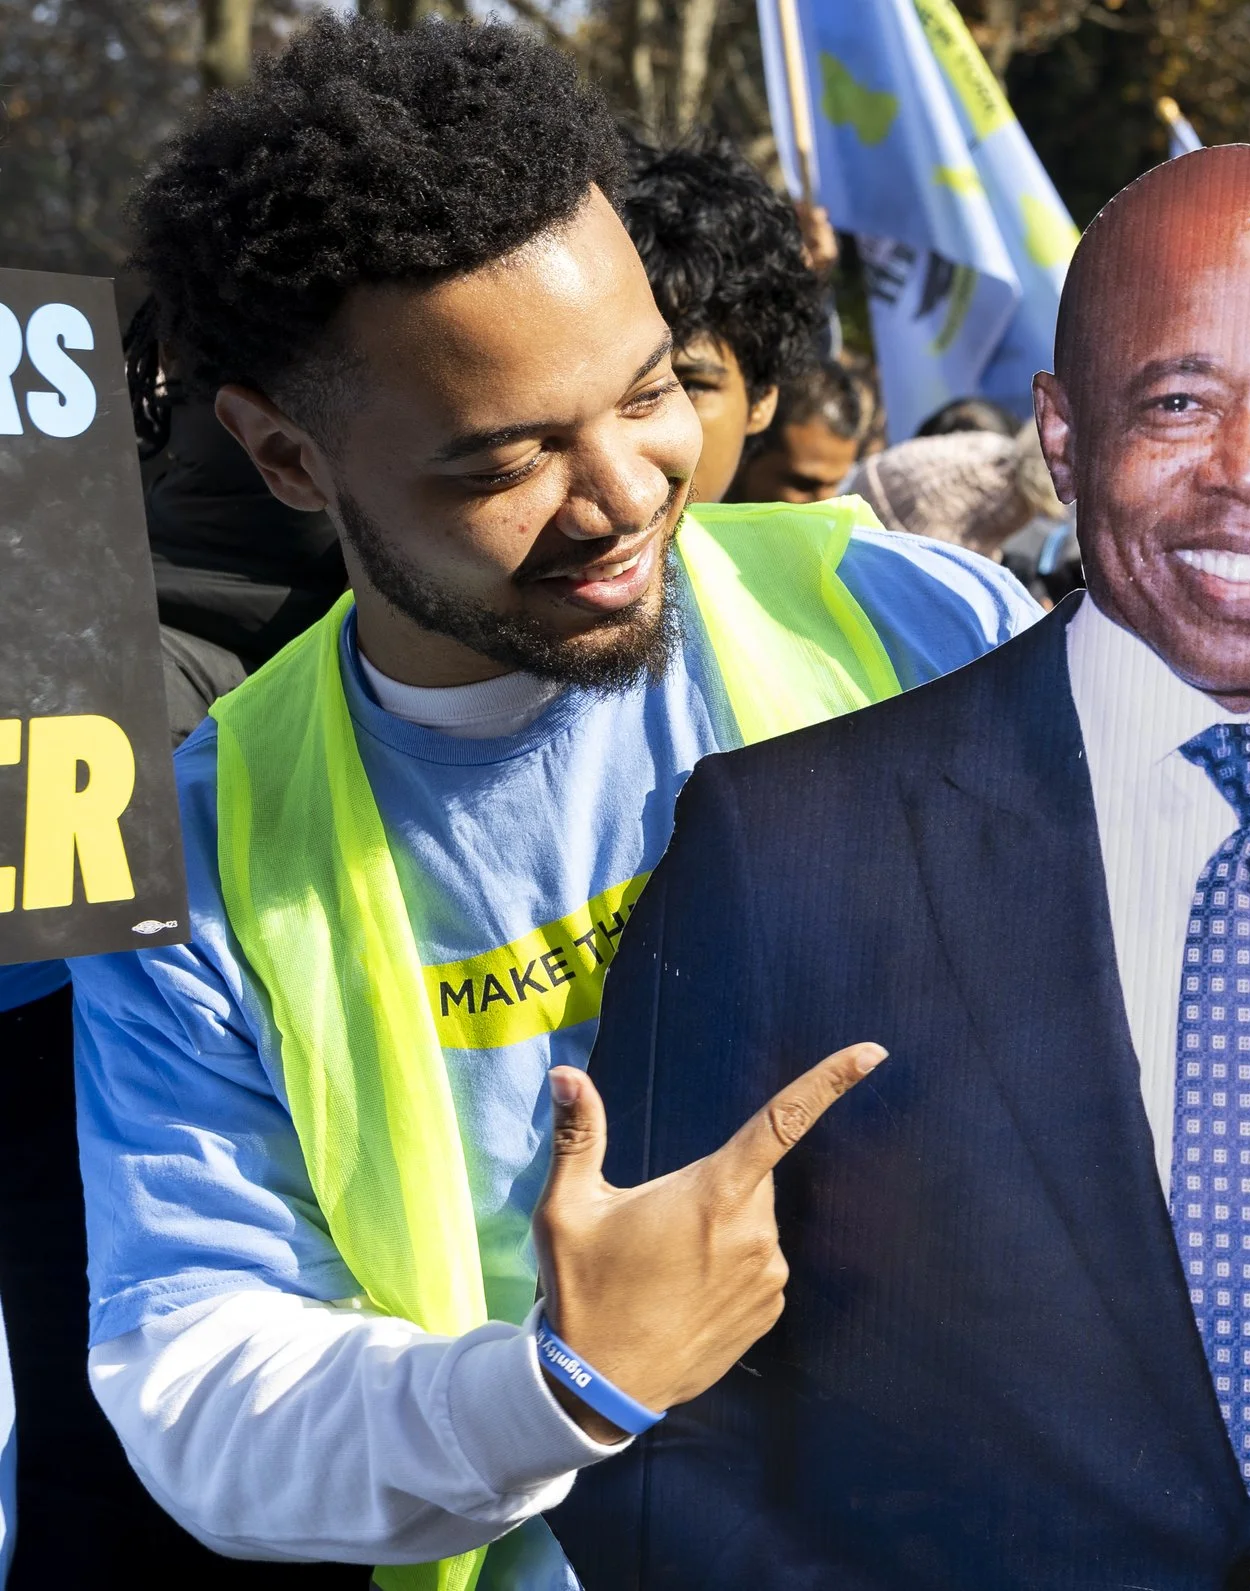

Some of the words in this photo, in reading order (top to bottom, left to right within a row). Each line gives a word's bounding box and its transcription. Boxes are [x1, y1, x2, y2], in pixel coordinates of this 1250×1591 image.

[440, 946, 576, 1017] MAKE
[573, 903, 635, 965] TH
[542, 1340, 592, 1388] Dignity
